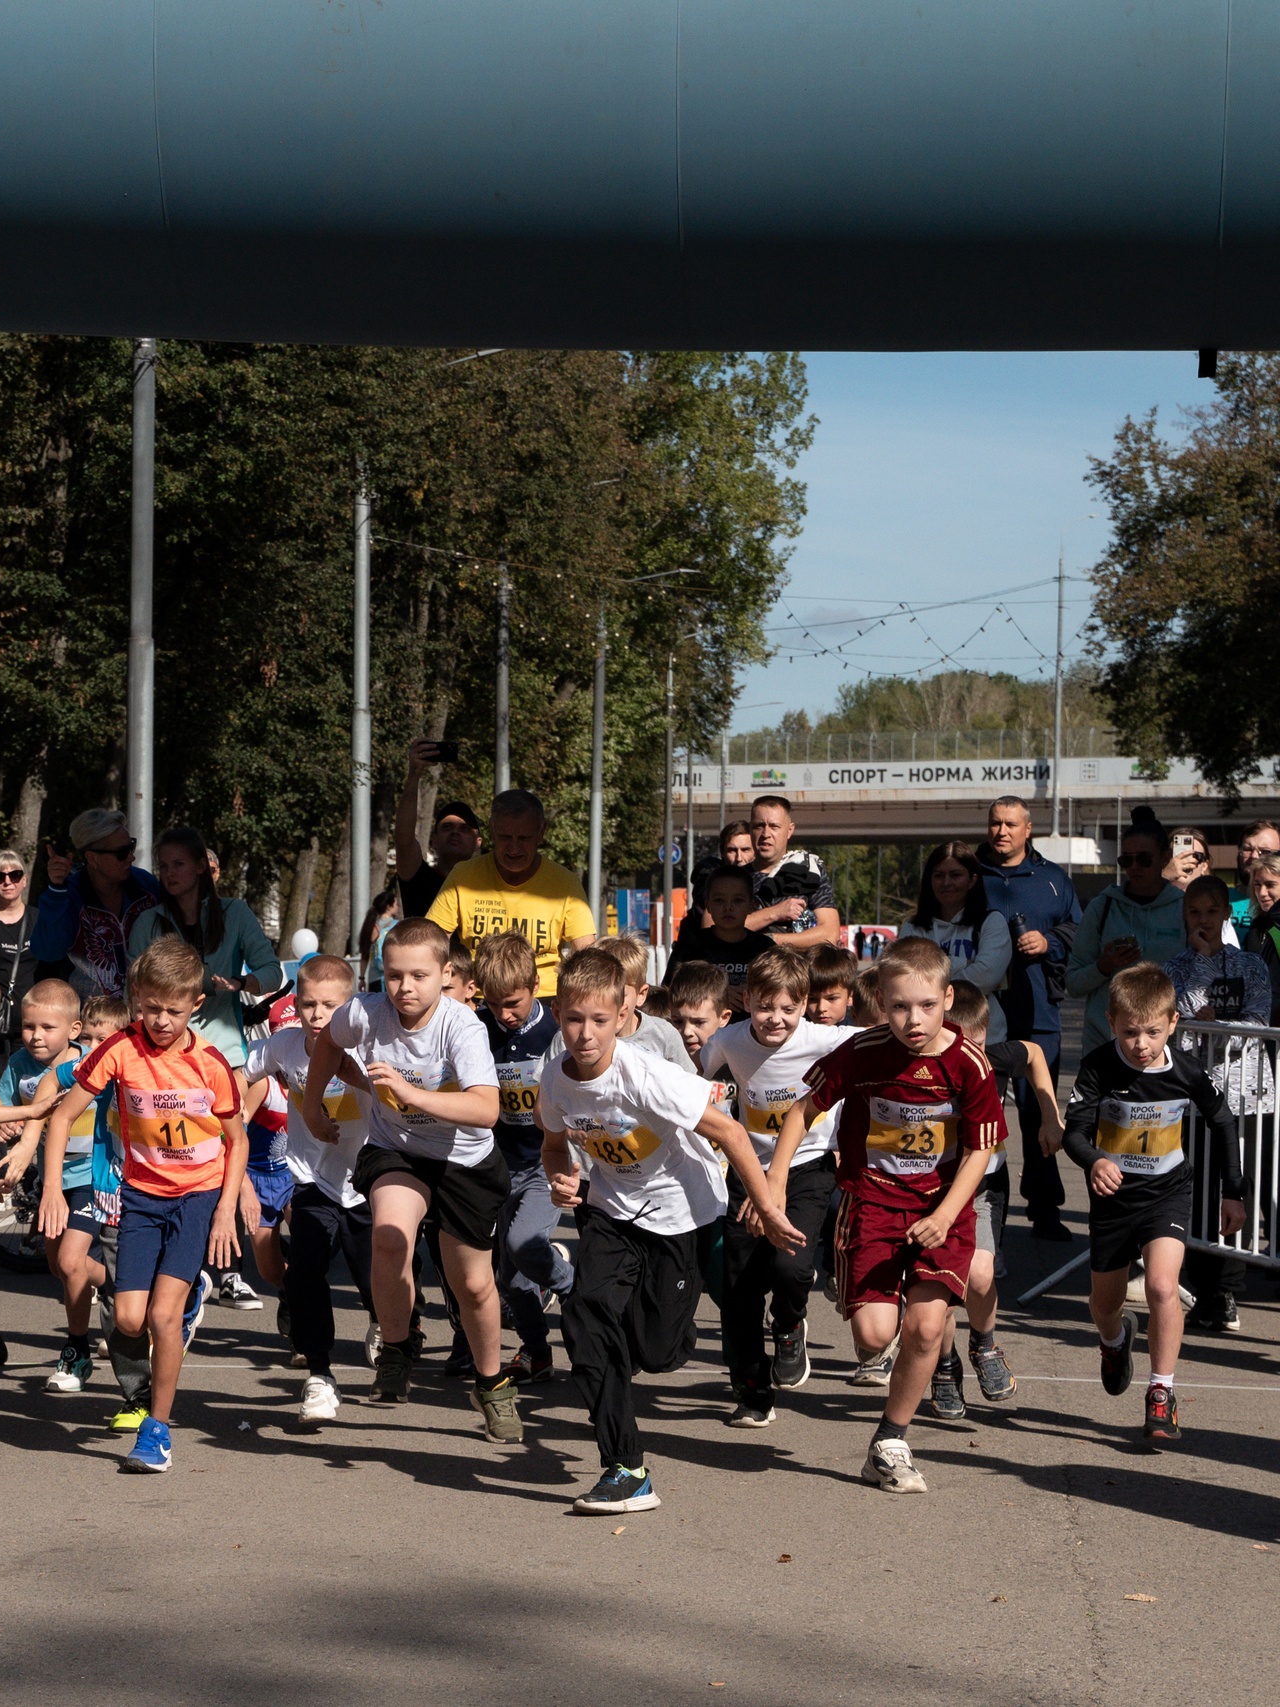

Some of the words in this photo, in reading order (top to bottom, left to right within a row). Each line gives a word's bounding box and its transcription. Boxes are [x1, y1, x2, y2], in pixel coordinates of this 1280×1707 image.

[828, 769, 888, 784] СПОРТ
[909, 767, 973, 782] НОРМА
[981, 765, 1051, 781] ЖИЗНИ
[765, 1088, 788, 1096] КРОСС
[152, 1094, 178, 1102] КРОСС
[766, 1092, 797, 1103] НАЦИИ
[153, 1101, 186, 1110] НАЦИИ
[1130, 1112, 1162, 1121] НАЦИИ
[1129, 1120, 1161, 1128] 2024
[159, 1120, 188, 1147] 11
[901, 1130, 935, 1154] 23
[1137, 1130, 1149, 1154] 1
[156, 1147, 196, 1155] РЯЗАНСКАЯ
[161, 1153, 194, 1161] ОБЛАСТЬ
[1120, 1154, 1160, 1164] РЯЗАНСКАЯ
[899, 1160, 933, 1169] ОБЛАСТЬ
[1123, 1160, 1155, 1170] ОБЛАСТЬ
